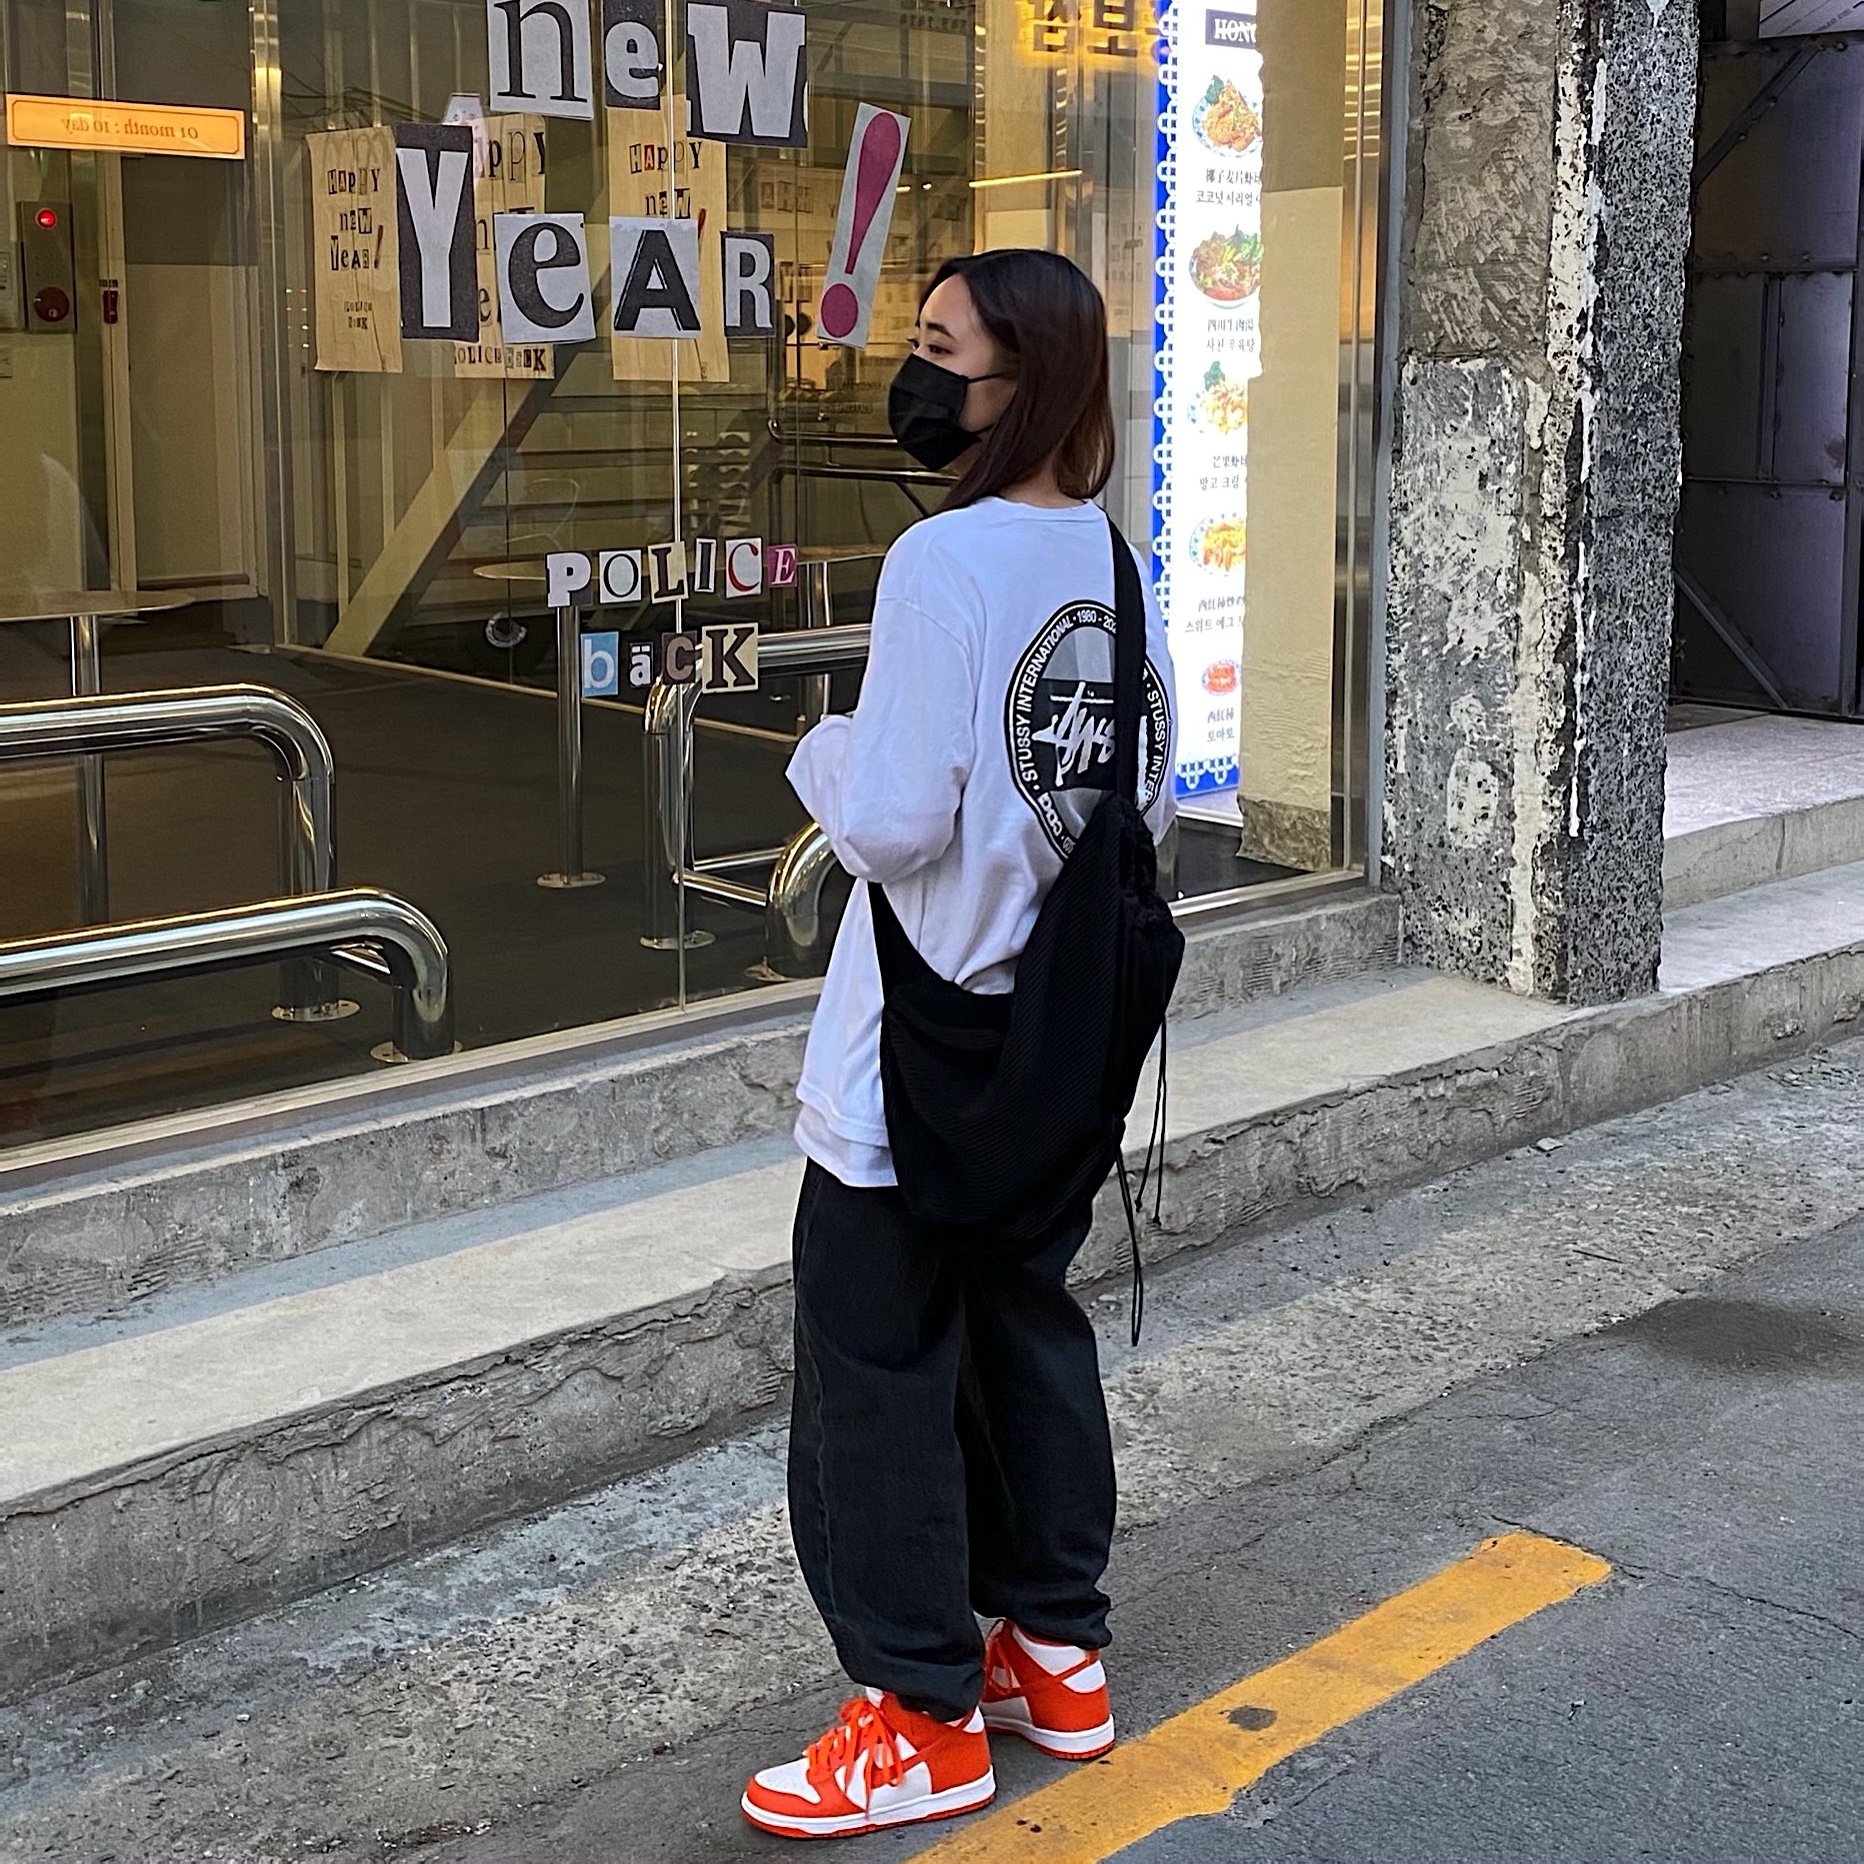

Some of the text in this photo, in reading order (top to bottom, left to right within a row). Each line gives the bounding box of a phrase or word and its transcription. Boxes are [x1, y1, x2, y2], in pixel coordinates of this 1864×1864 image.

[494, 0, 806, 138] neW
[1196, 190, 1223, 205] 코코넛
[1226, 191, 1253, 207] 시리얼
[1200, 476, 1218, 491] 망고
[547, 543, 796, 607] POLICE
[1185, 618, 1213, 633] 스위트
[1015, 615, 1074, 713] INTERNATIONAL
[1016, 714, 1039, 782] STUSSY
[1147, 690, 1166, 752] STUSSY
